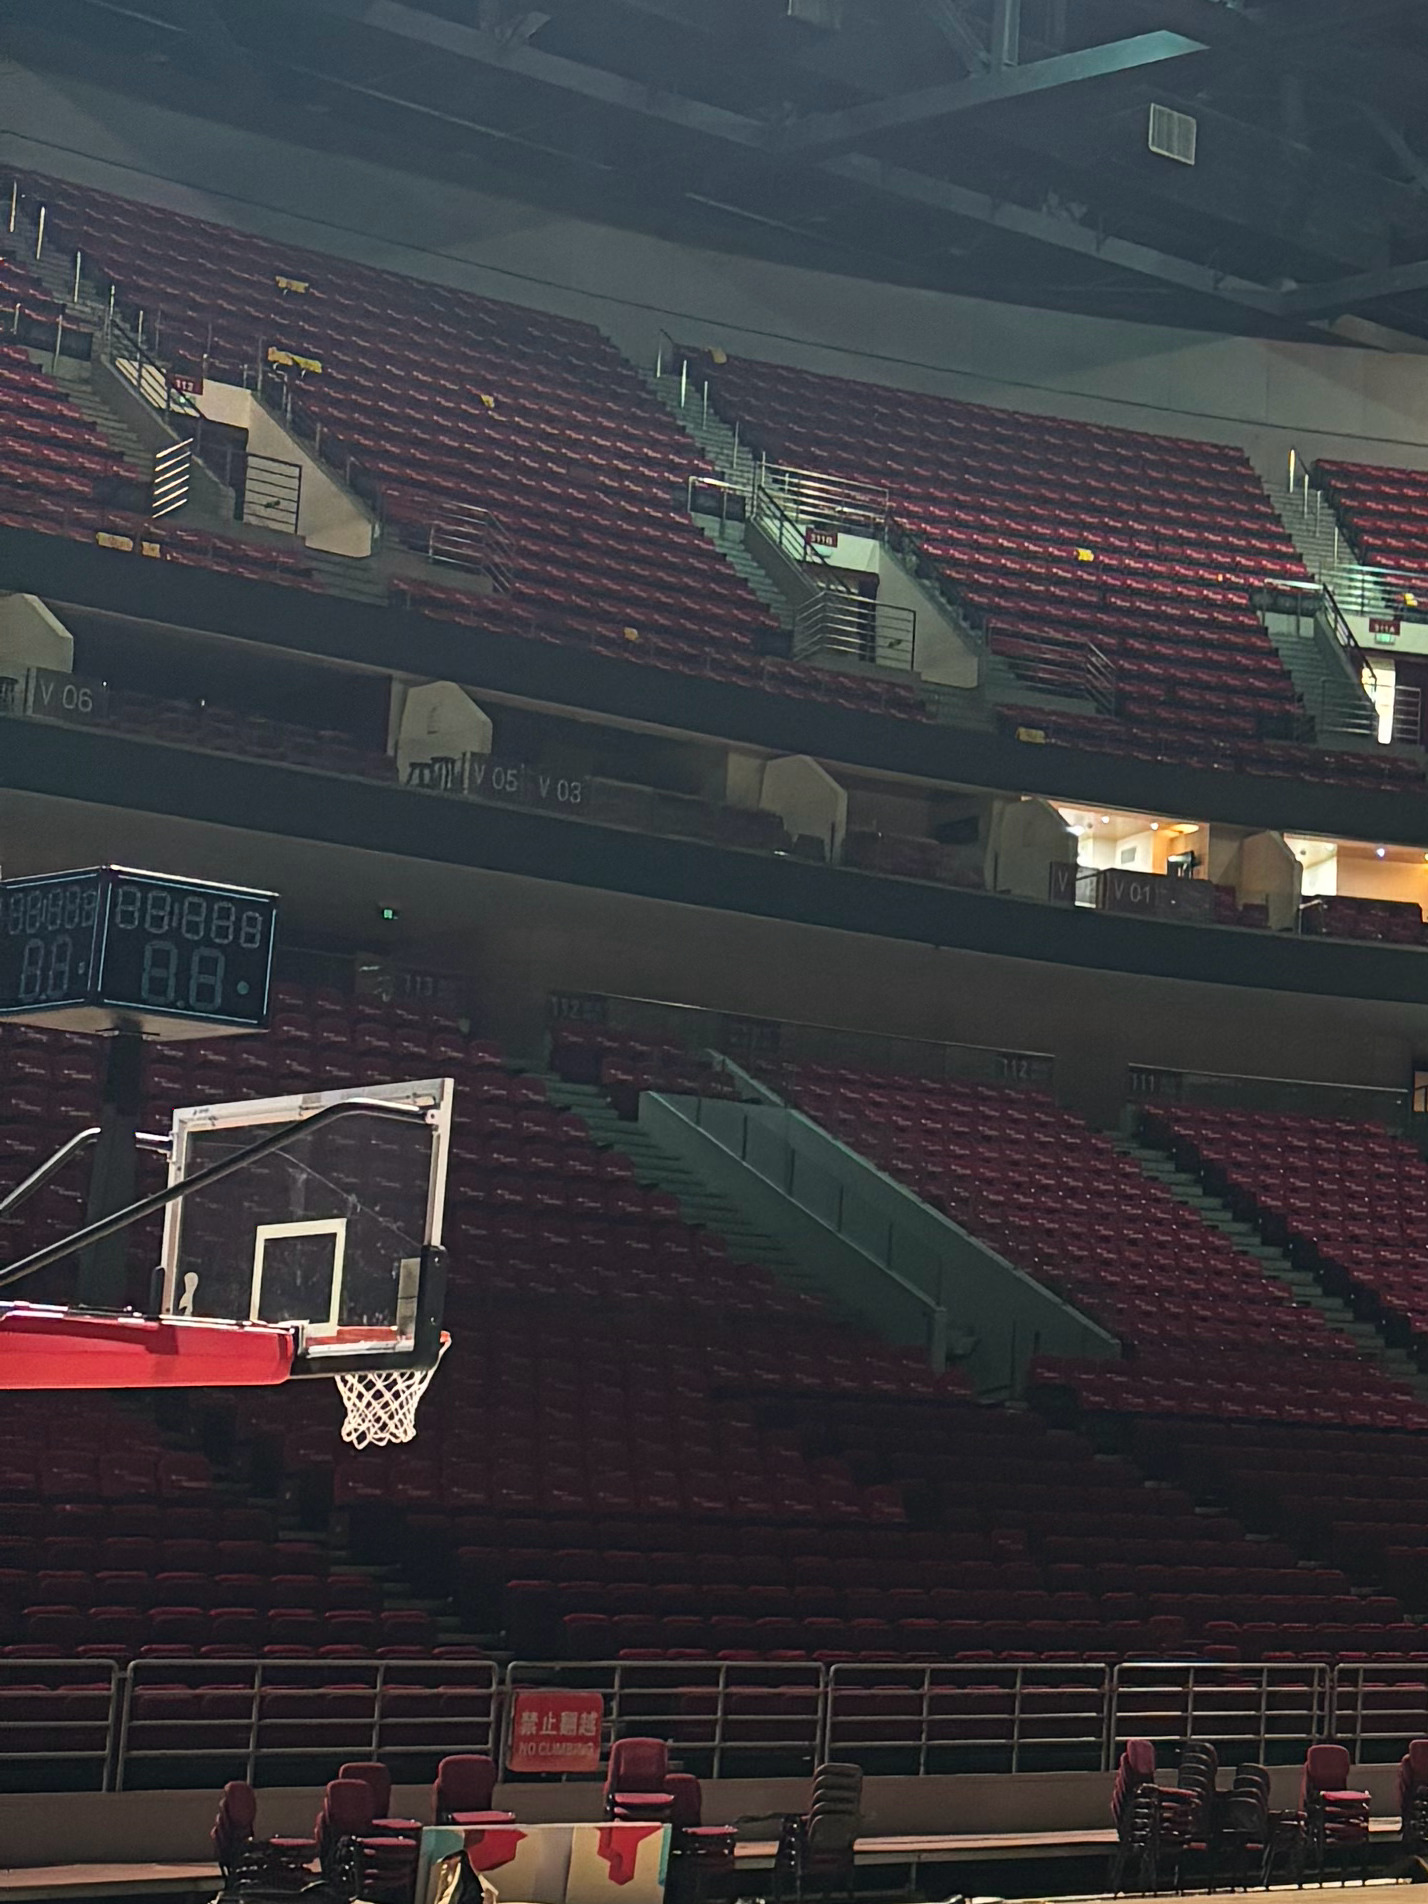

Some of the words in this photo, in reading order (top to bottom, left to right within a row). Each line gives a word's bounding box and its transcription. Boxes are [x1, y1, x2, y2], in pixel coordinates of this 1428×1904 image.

[41, 679, 55, 705] V
[63, 684, 94, 712] 06
[473, 762, 485, 784] V
[492, 767, 518, 791] 05
[539, 775, 551, 798] V
[556, 780, 582, 803] 03
[1115, 879, 1124, 901] V
[1130, 882, 1150, 904] 01
[1132, 1073, 1154, 1092] 111
[520, 1709, 598, 1736] 禁止翻越
[519, 1741, 537, 1756] NO
